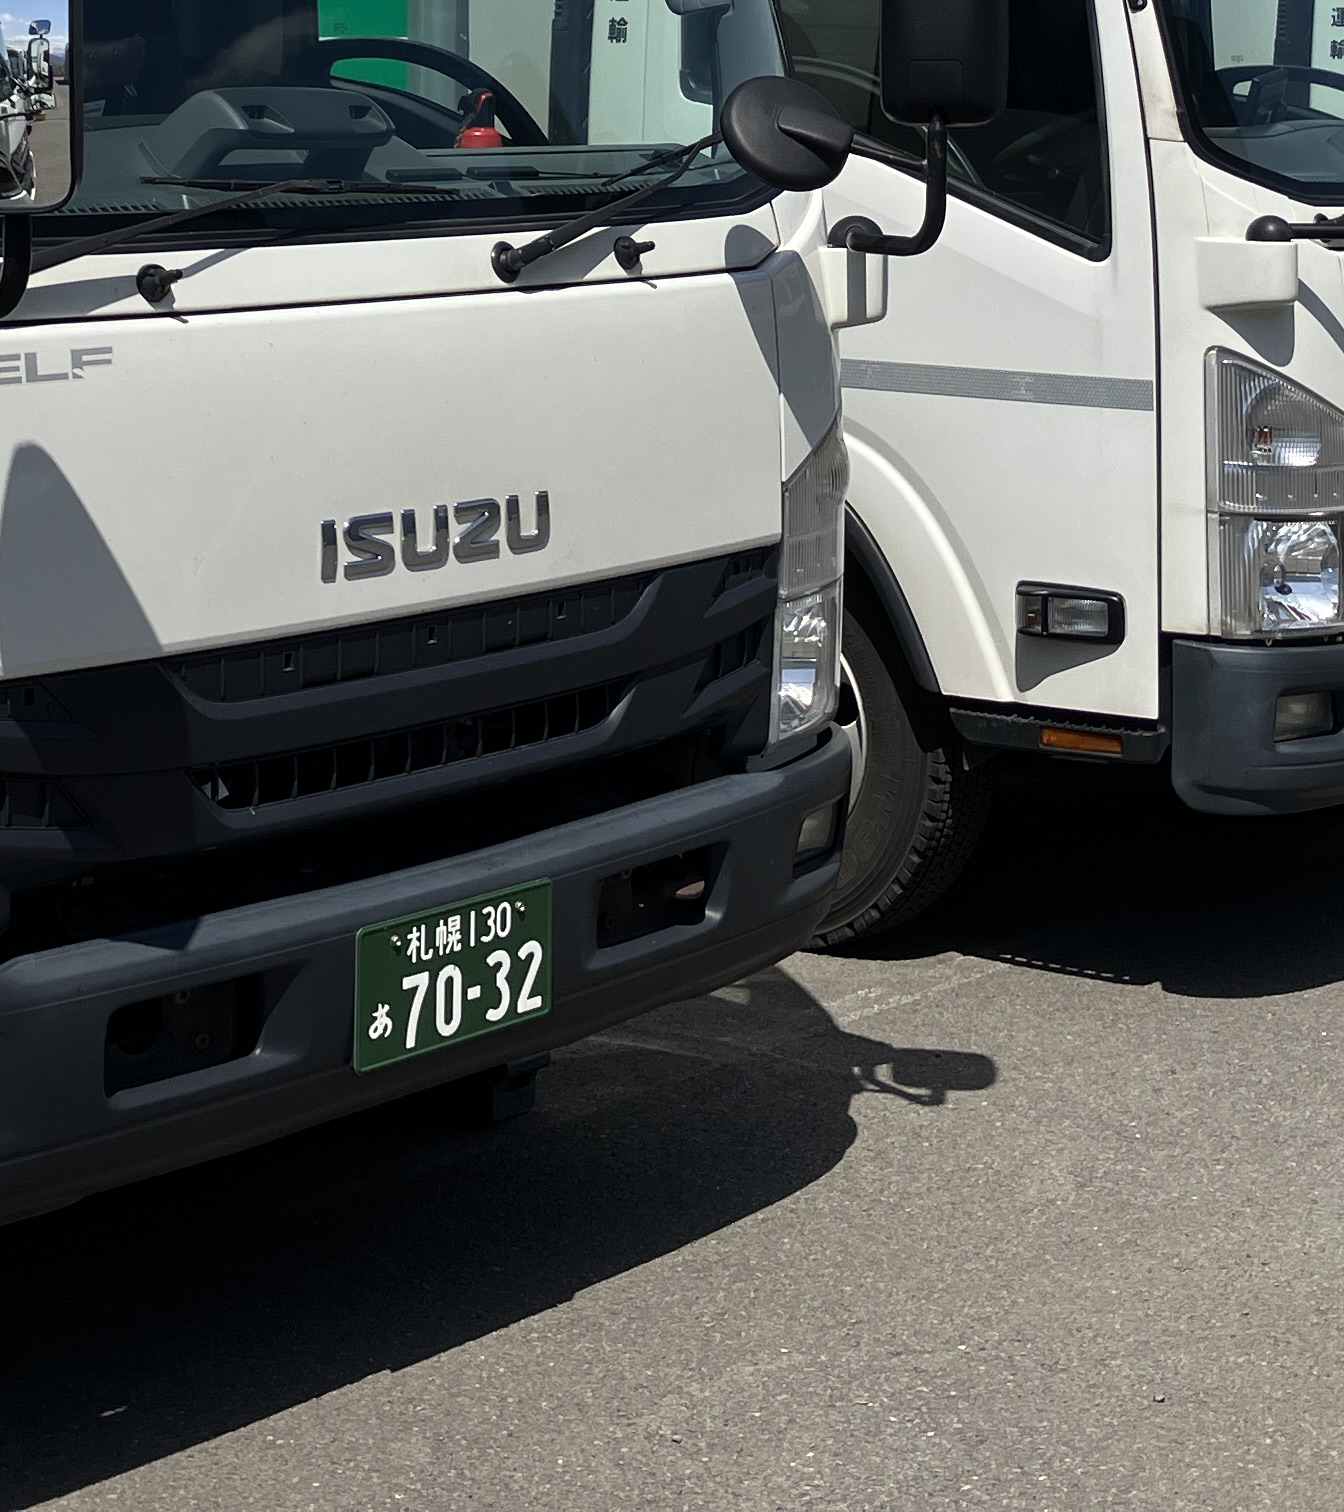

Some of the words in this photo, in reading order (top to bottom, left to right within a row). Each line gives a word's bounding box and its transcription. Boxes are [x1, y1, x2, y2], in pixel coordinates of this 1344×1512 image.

[321, 490, 551, 584] ISUZU
[368, 1003, 394, 1040] あ
[402, 940, 543, 1050] 70-32
